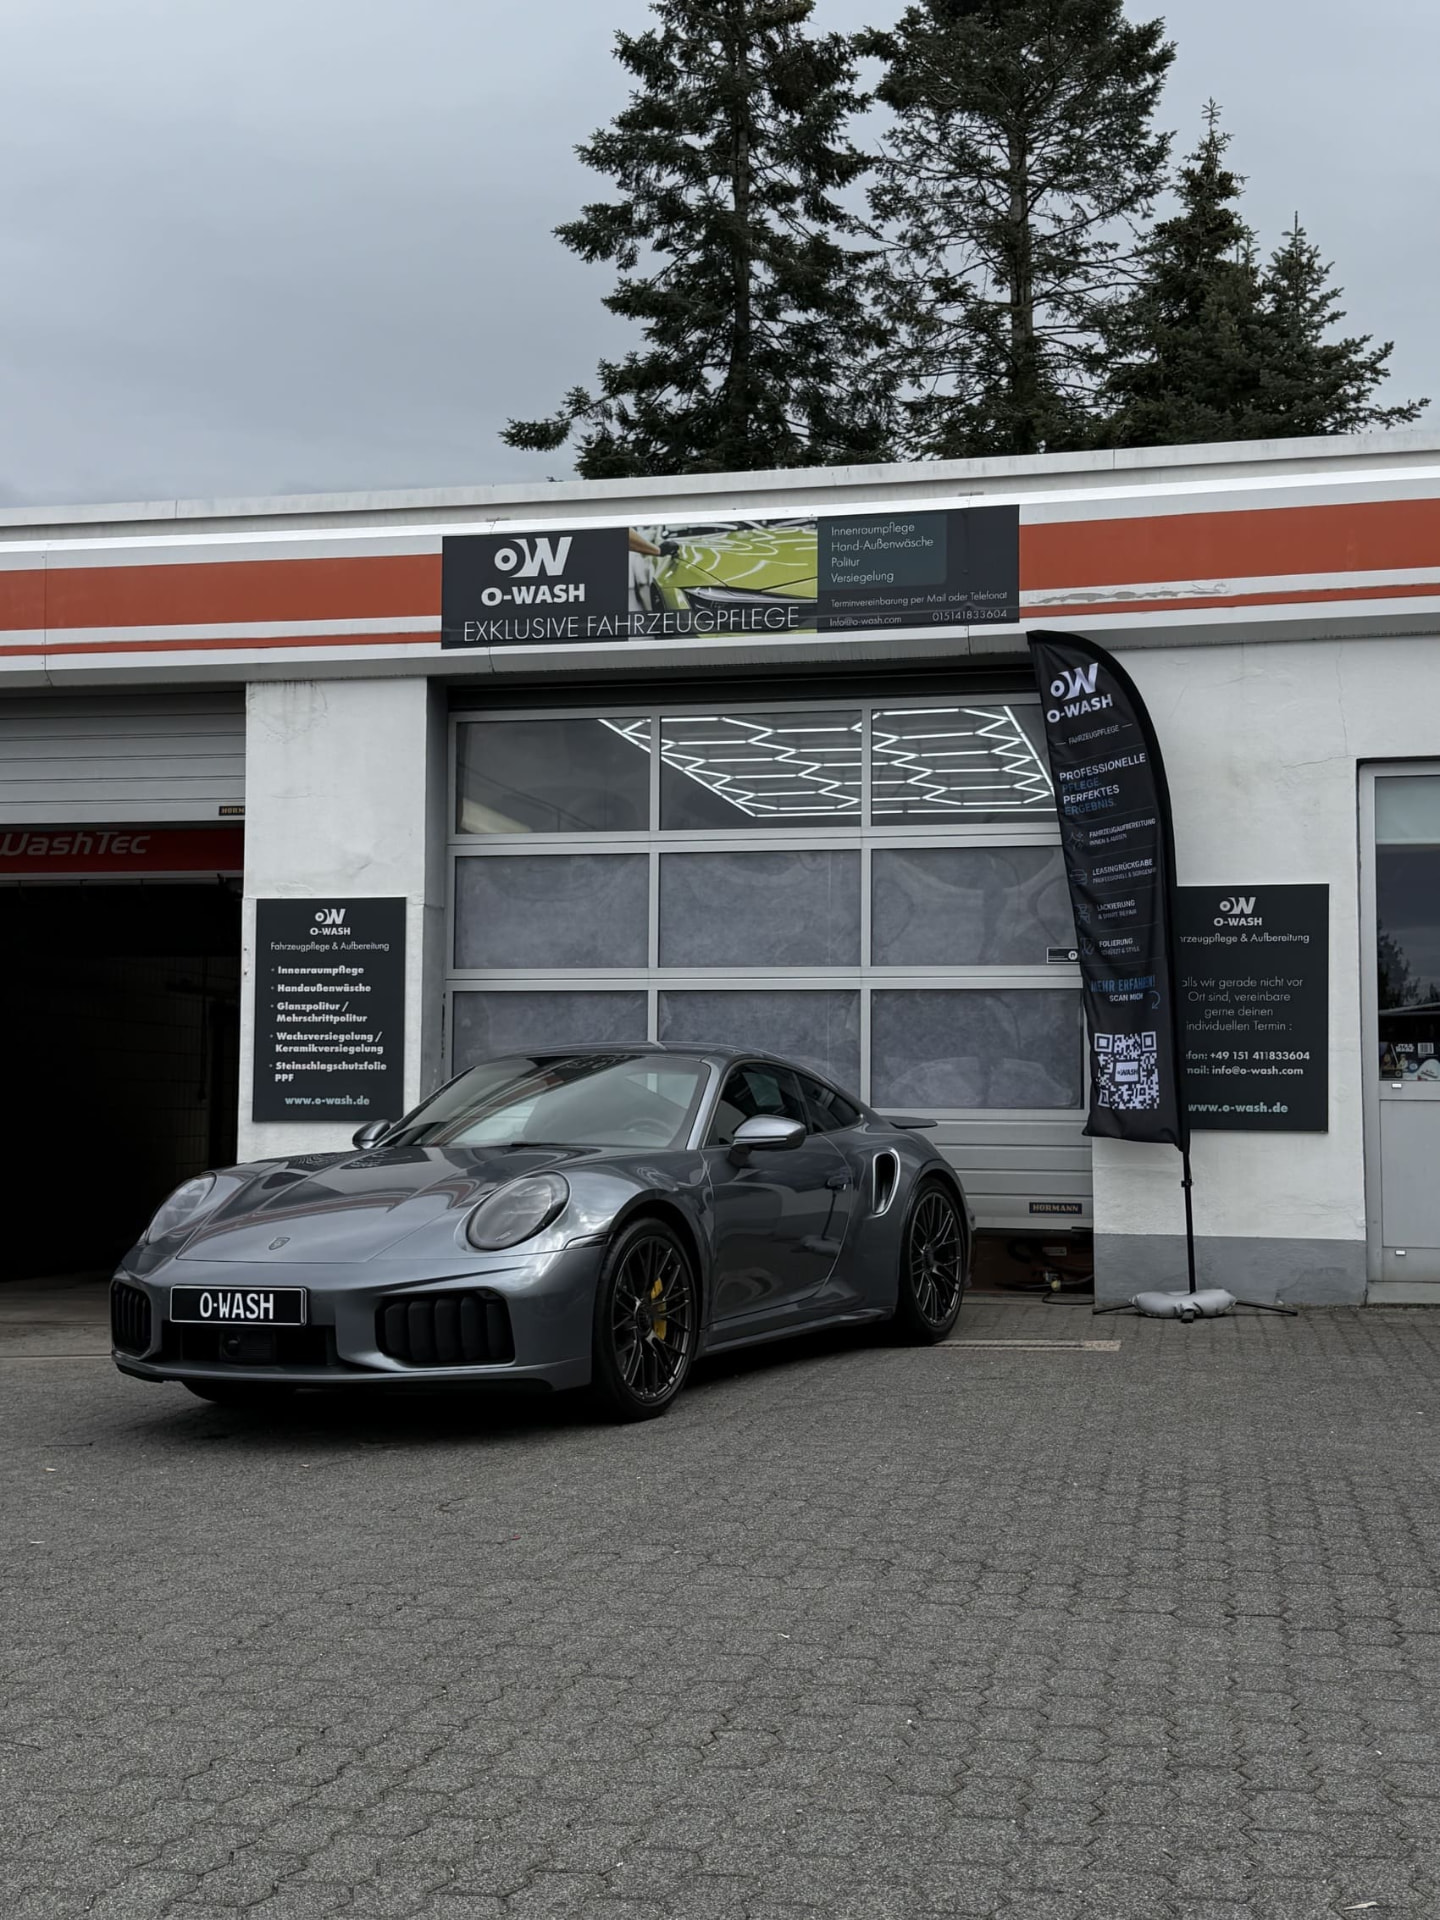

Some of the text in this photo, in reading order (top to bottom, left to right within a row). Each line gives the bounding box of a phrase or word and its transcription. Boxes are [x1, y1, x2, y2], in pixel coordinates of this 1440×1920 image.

[831, 521, 915, 536] Innenraumpflege
[831, 536, 934, 552] Hand-Außenwäsche
[831, 556, 860, 568] Politur
[830, 570, 895, 585] Versiegelung
[481, 583, 585, 607] O-WASH
[831, 591, 1008, 609] Terminvereinbarung per Mail oder Telefonat
[932, 609, 1007, 622] 015141833604
[464, 606, 799, 642] EXKLUSIVE FAHRZEUGPFLEGE
[1046, 693, 1114, 723] O-WASH
[1068, 724, 1120, 745] FAHRZEUGPFLEGE
[1059, 752, 1146, 782] PROFESSIONELLE
[1063, 784, 1120, 805] PERFEKTES
[1092, 858, 1153, 876] LEASINGRÜCKGABE
[1213, 917, 1263, 927] O-WASH
[310, 927, 351, 937] O-WASH
[1240, 933, 1248, 943] &
[1250, 932, 1310, 944] Aufbereitung
[270, 941, 390, 952] Fahrzeugpflege & Aufbereitung
[1098, 937, 1133, 948] FOLIERUNG
[278, 965, 364, 977] Innenraumpflege
[277, 983, 371, 993] Handaußenwäsche
[1200, 977, 1215, 988] wir
[1218, 976, 1257, 990] gerade
[1260, 975, 1284, 988] nicht
[1286, 979, 1303, 988] vor
[1109, 994, 1129, 1002] SCAN
[1188, 990, 1291, 1004] Ort sind, vereinbare
[276, 1001, 341, 1013] Glanzpolitur
[1204, 1005, 1273, 1020] gerne deinen
[276, 1013, 368, 1025] Mehrschrittpolitur
[1186, 1019, 1250, 1031] individuellen
[1253, 1019, 1286, 1031] Termin
[276, 1031, 374, 1043] Wachsversiegelung
[275, 1043, 384, 1055] Keramikversiegelung
[1210, 1051, 1230, 1060] +49
[1232, 1051, 1249, 1060] 151
[275, 1061, 387, 1072] Steinschlagschutzfolie
[1212, 1065, 1304, 1075] info@o-wash.com
[274, 1073, 294, 1082] PPF
[284, 1095, 370, 1105] www.o-wash.de
[1188, 1101, 1289, 1113] www.o-wash.de
[199, 1292, 274, 1320] O-WASH
